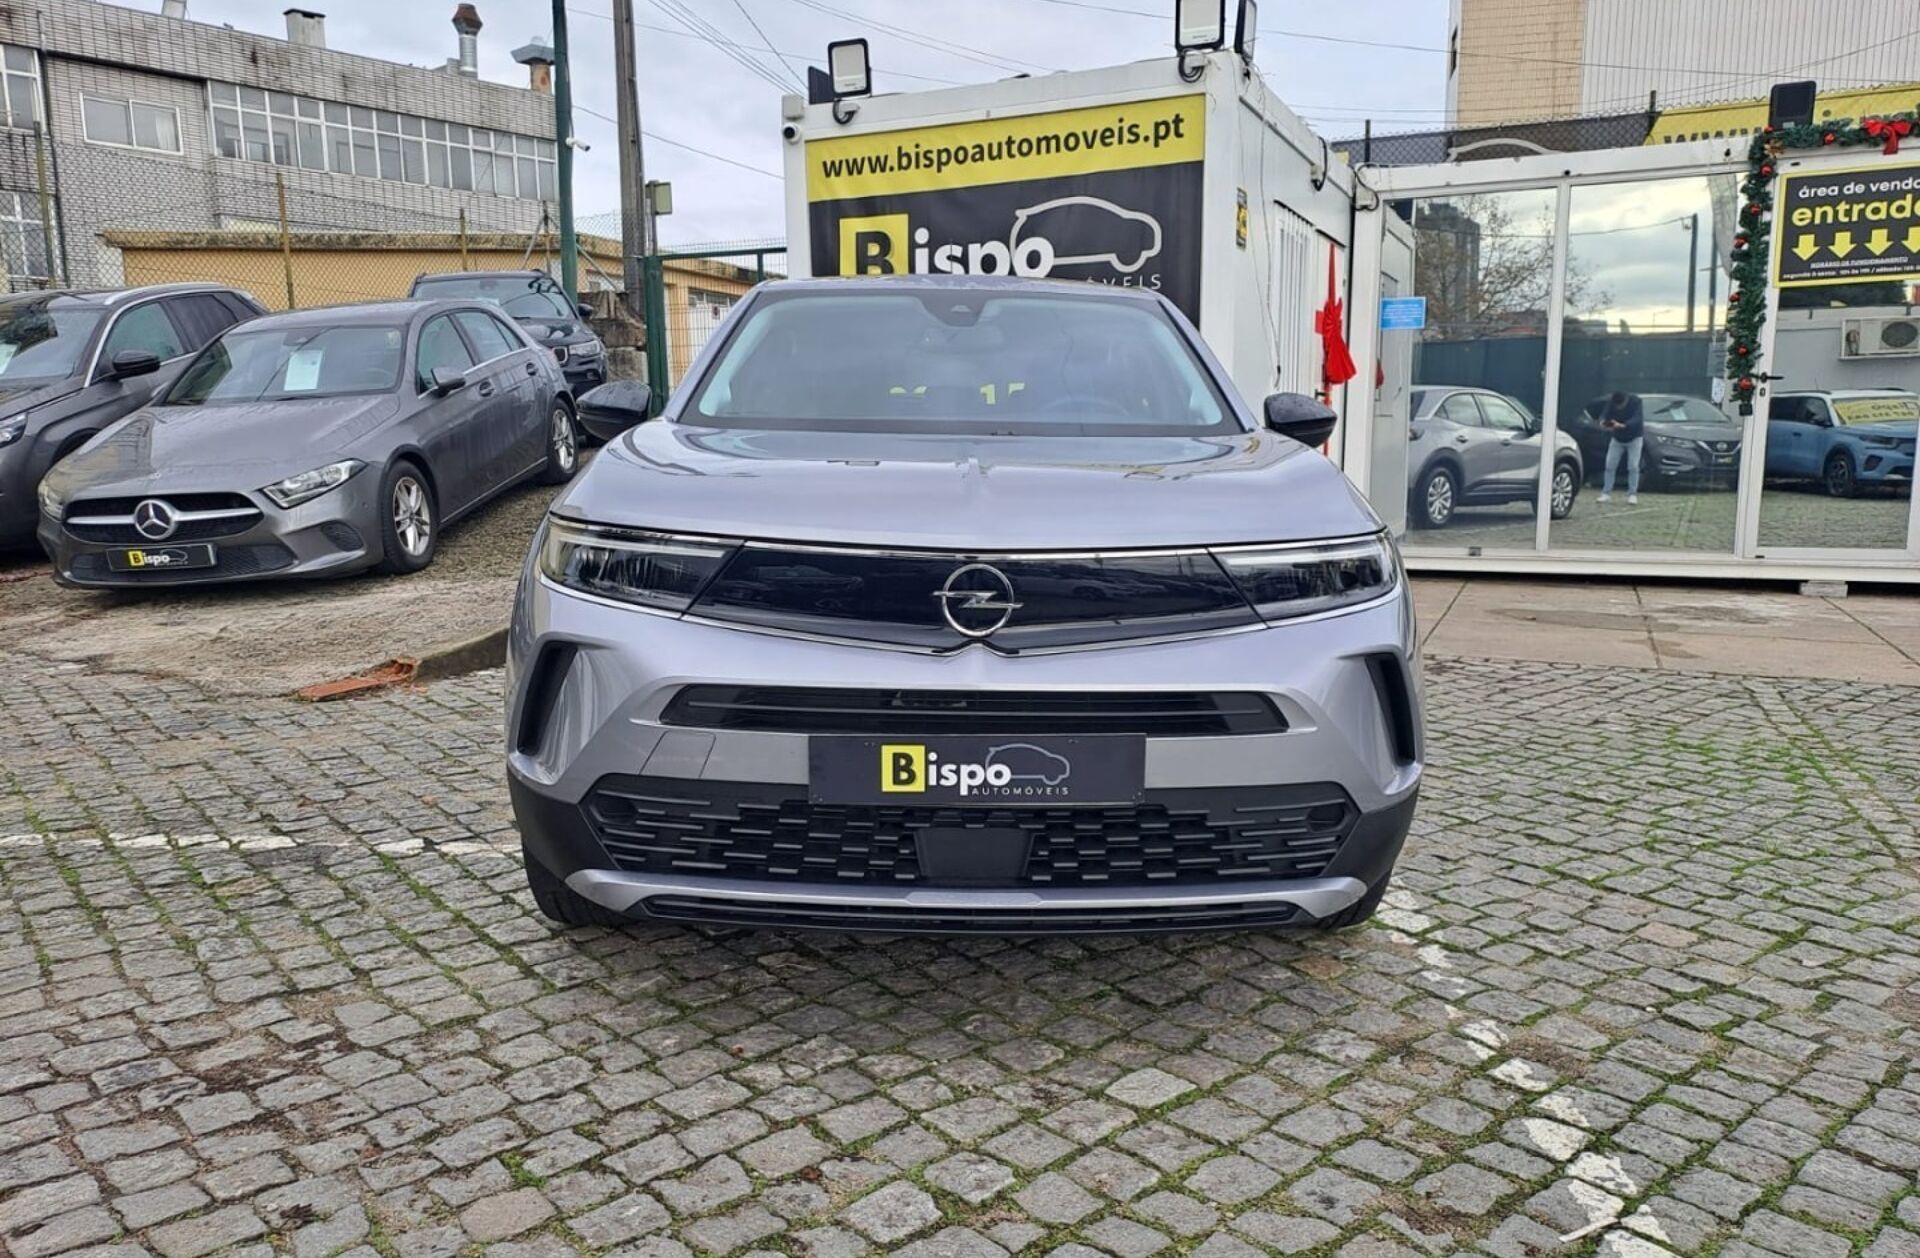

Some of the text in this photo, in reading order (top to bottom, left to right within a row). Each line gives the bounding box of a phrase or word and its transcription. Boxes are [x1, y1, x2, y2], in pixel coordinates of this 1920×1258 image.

[822, 113, 1184, 179] www.bispoautomoveis.pt
[1798, 185, 1839, 198] área
[1843, 182, 1865, 194] de
[131, 551, 171, 567] Bispo
[892, 751, 1012, 796] Bispo
[971, 785, 1069, 796] AUTOMÓVEIS
